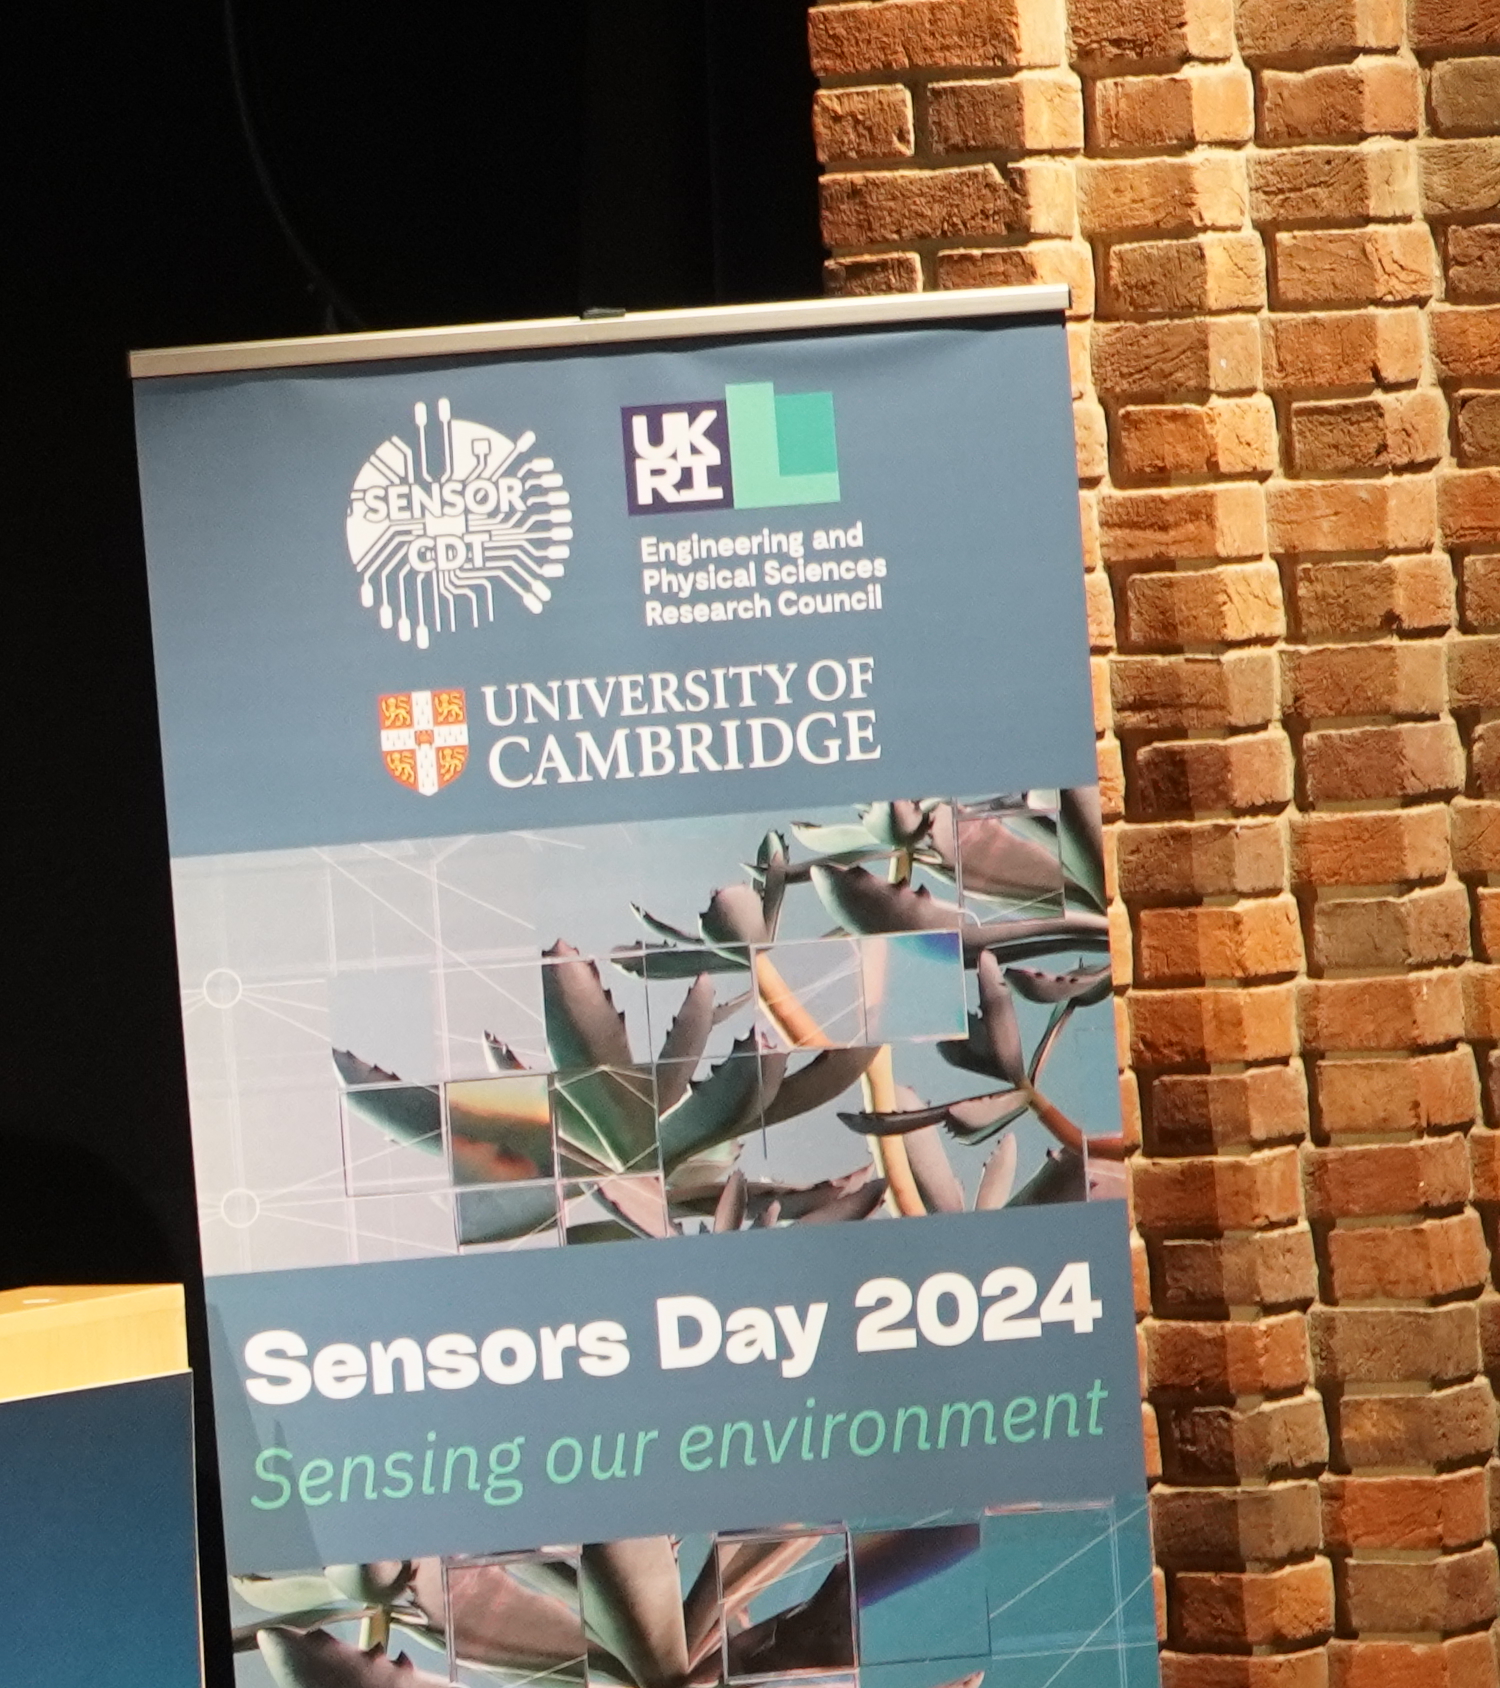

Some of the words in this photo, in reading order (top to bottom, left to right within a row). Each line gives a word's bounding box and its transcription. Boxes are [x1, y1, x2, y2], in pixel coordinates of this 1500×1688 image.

[364, 477, 526, 523] SENSOR
[408, 531, 491, 572] CDT
[640, 527, 804, 567] Engineering
[812, 520, 864, 551] and
[643, 561, 757, 598] Physical
[764, 556, 887, 585] Sciences
[645, 592, 772, 627] Research
[778, 583, 883, 616] Council
[481, 661, 798, 726] UNIVERSITY
[806, 656, 875, 702] OF
[488, 709, 882, 789] CAMBRIDGE
[244, 1320, 631, 1405] Sensors
[656, 1294, 829, 1378] Day
[854, 1261, 1103, 1353] 2024
[250, 1430, 526, 1511] Sensing
[545, 1428, 659, 1485] our
[679, 1378, 1109, 1472] environment
